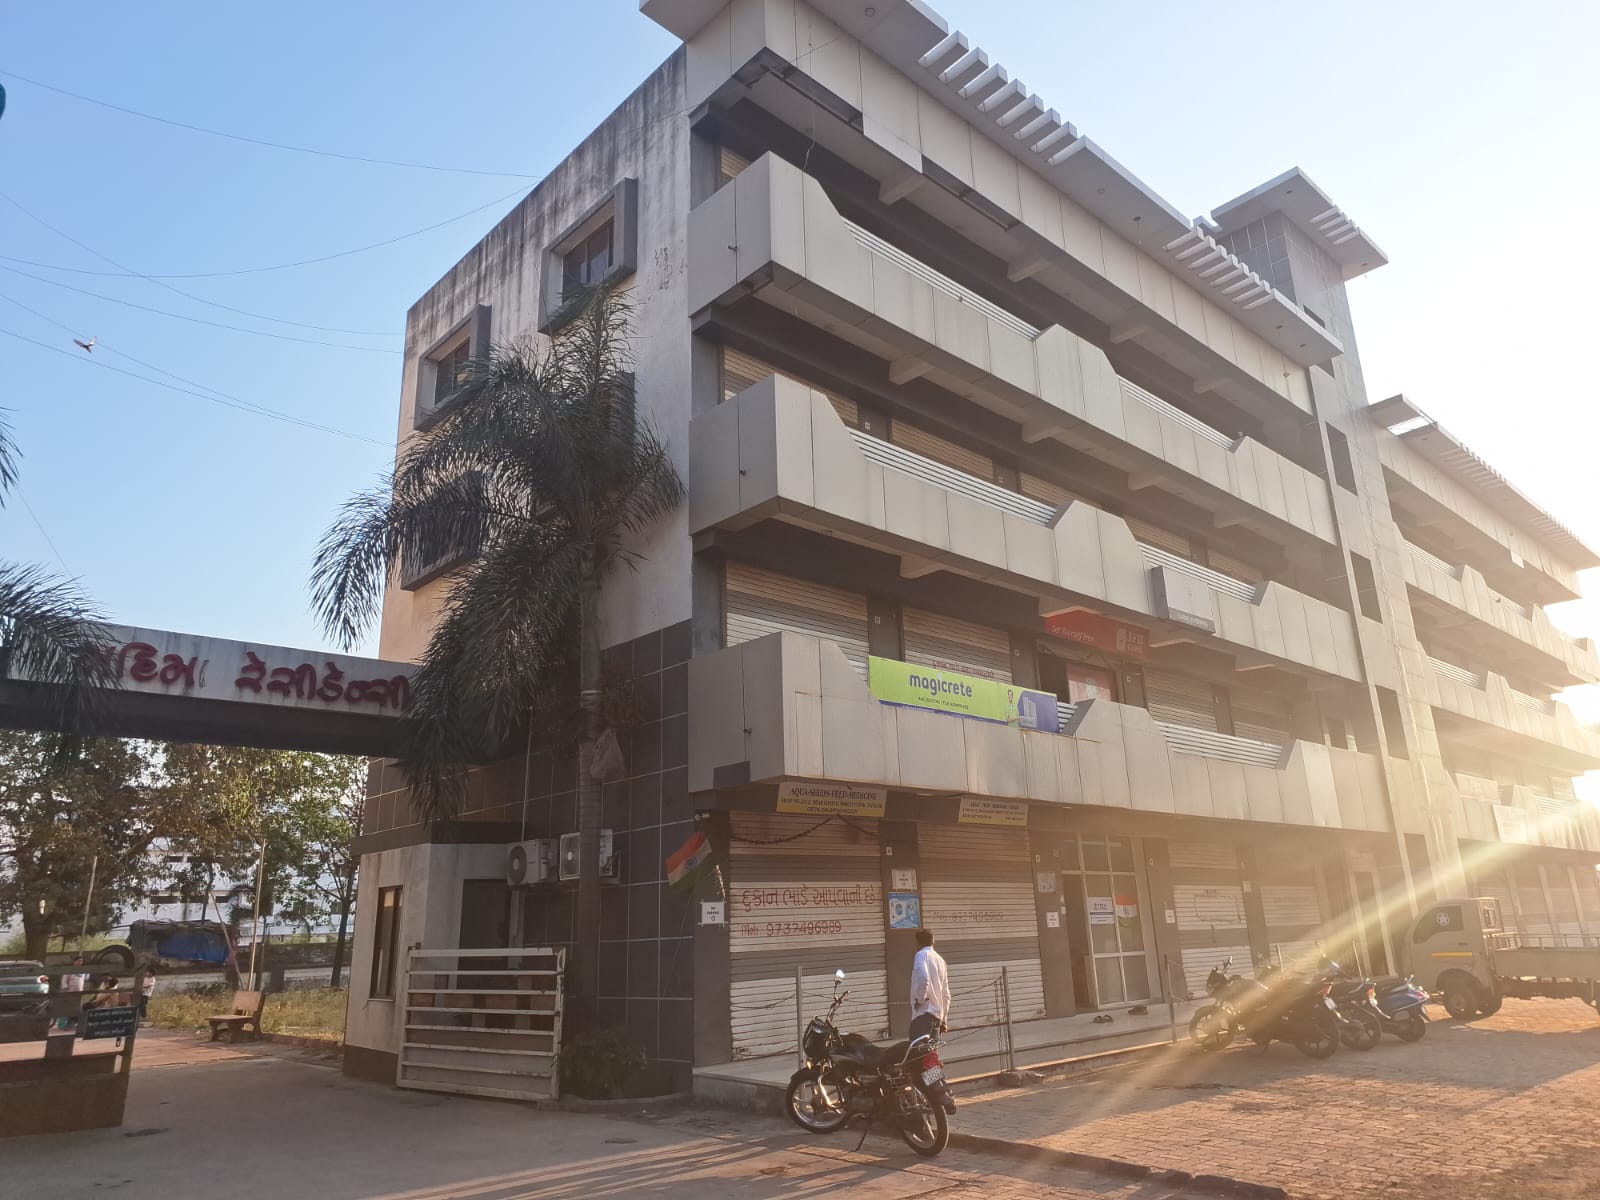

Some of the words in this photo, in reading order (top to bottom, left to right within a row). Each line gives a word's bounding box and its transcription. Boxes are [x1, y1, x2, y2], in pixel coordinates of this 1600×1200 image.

[909, 673, 973, 698] magicrete
[742, 889, 779, 912] દુકાન
[782, 883, 808, 906] ભાડે
[812, 884, 862, 906] આપવાની
